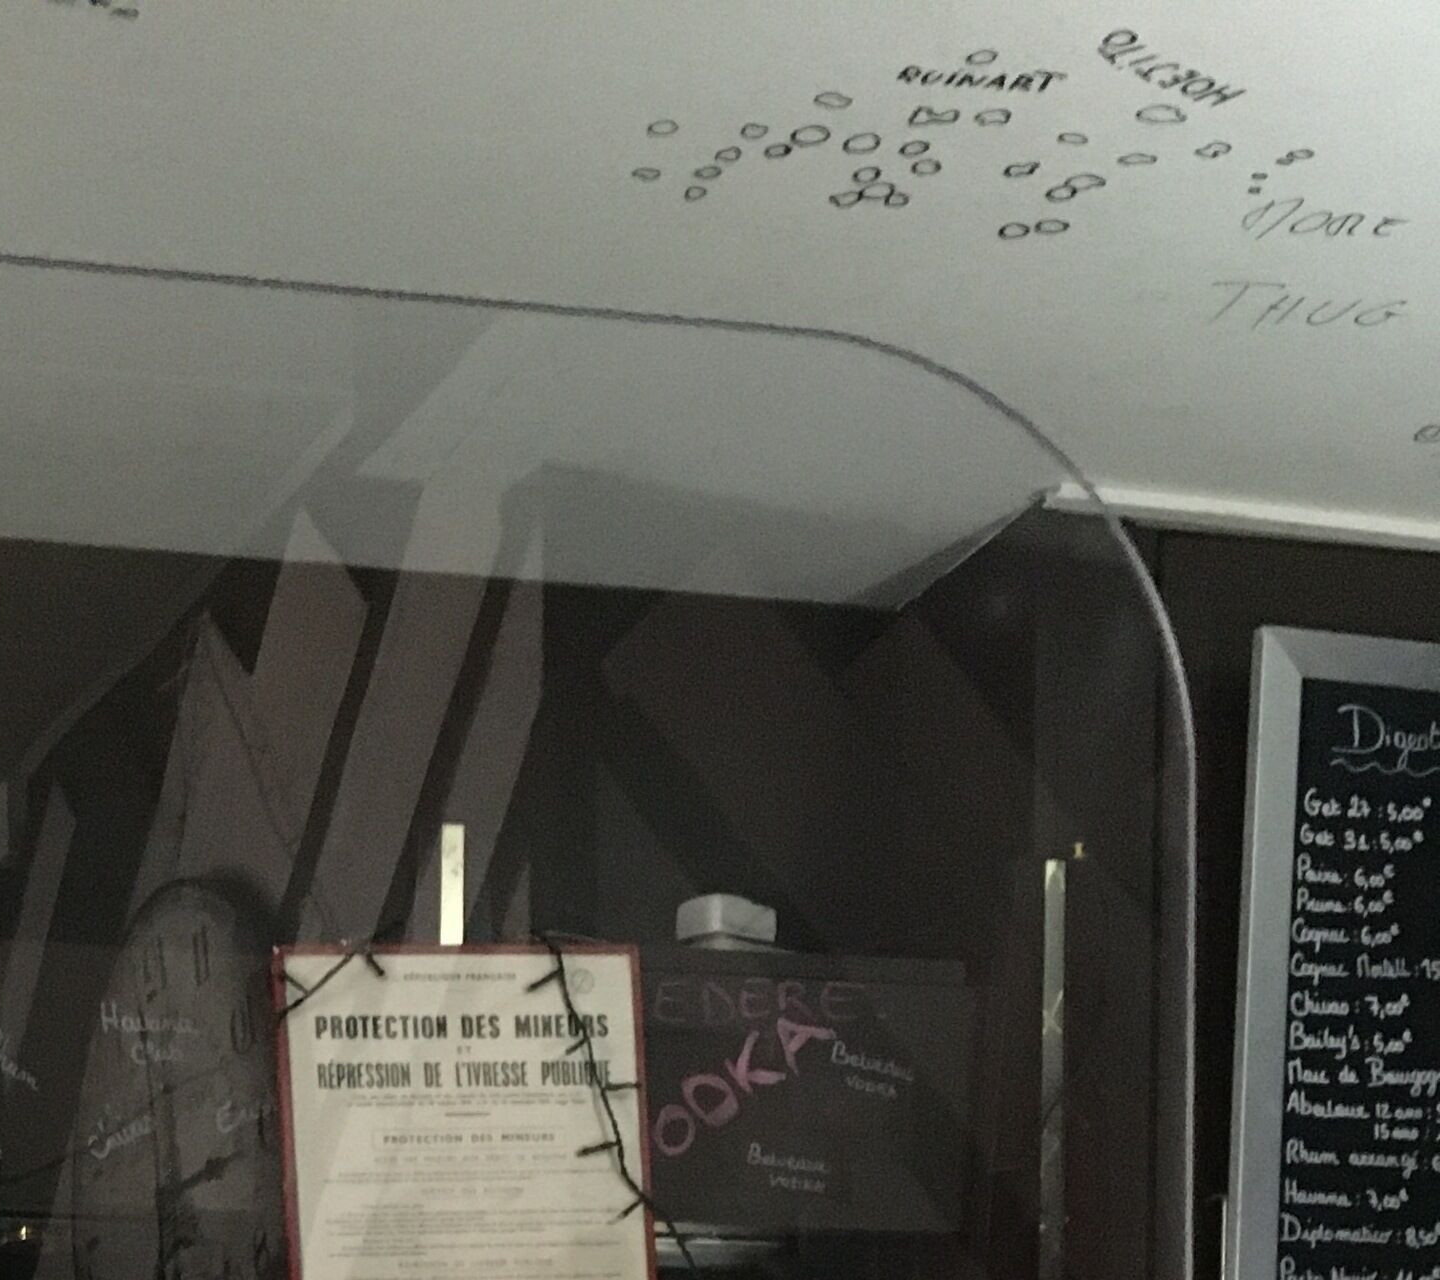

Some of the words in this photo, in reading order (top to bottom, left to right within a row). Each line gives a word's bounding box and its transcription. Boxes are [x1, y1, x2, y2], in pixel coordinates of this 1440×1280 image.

[897, 64, 1068, 96] RUINART
[1209, 277, 1411, 332] THUG
[1303, 787, 1342, 817] Get
[1299, 822, 1336, 847] Get
[314, 1013, 449, 1040] PROTECTION
[460, 1014, 501, 1039] DES
[514, 1013, 609, 1039] MINEURS
[316, 1059, 412, 1090] RÉPRESSION
[424, 1062, 442, 1088] DE
[455, 1060, 529, 1088] L'IVRESSE
[540, 1059, 611, 1088] PUBLIQUE
[650, 1016, 838, 1158] ODKA
[383, 1134, 460, 1146] PROTECTION
[471, 1134, 494, 1144] DES
[501, 1132, 556, 1144] MINEURS
[1286, 1137, 1341, 1166] Rhum
